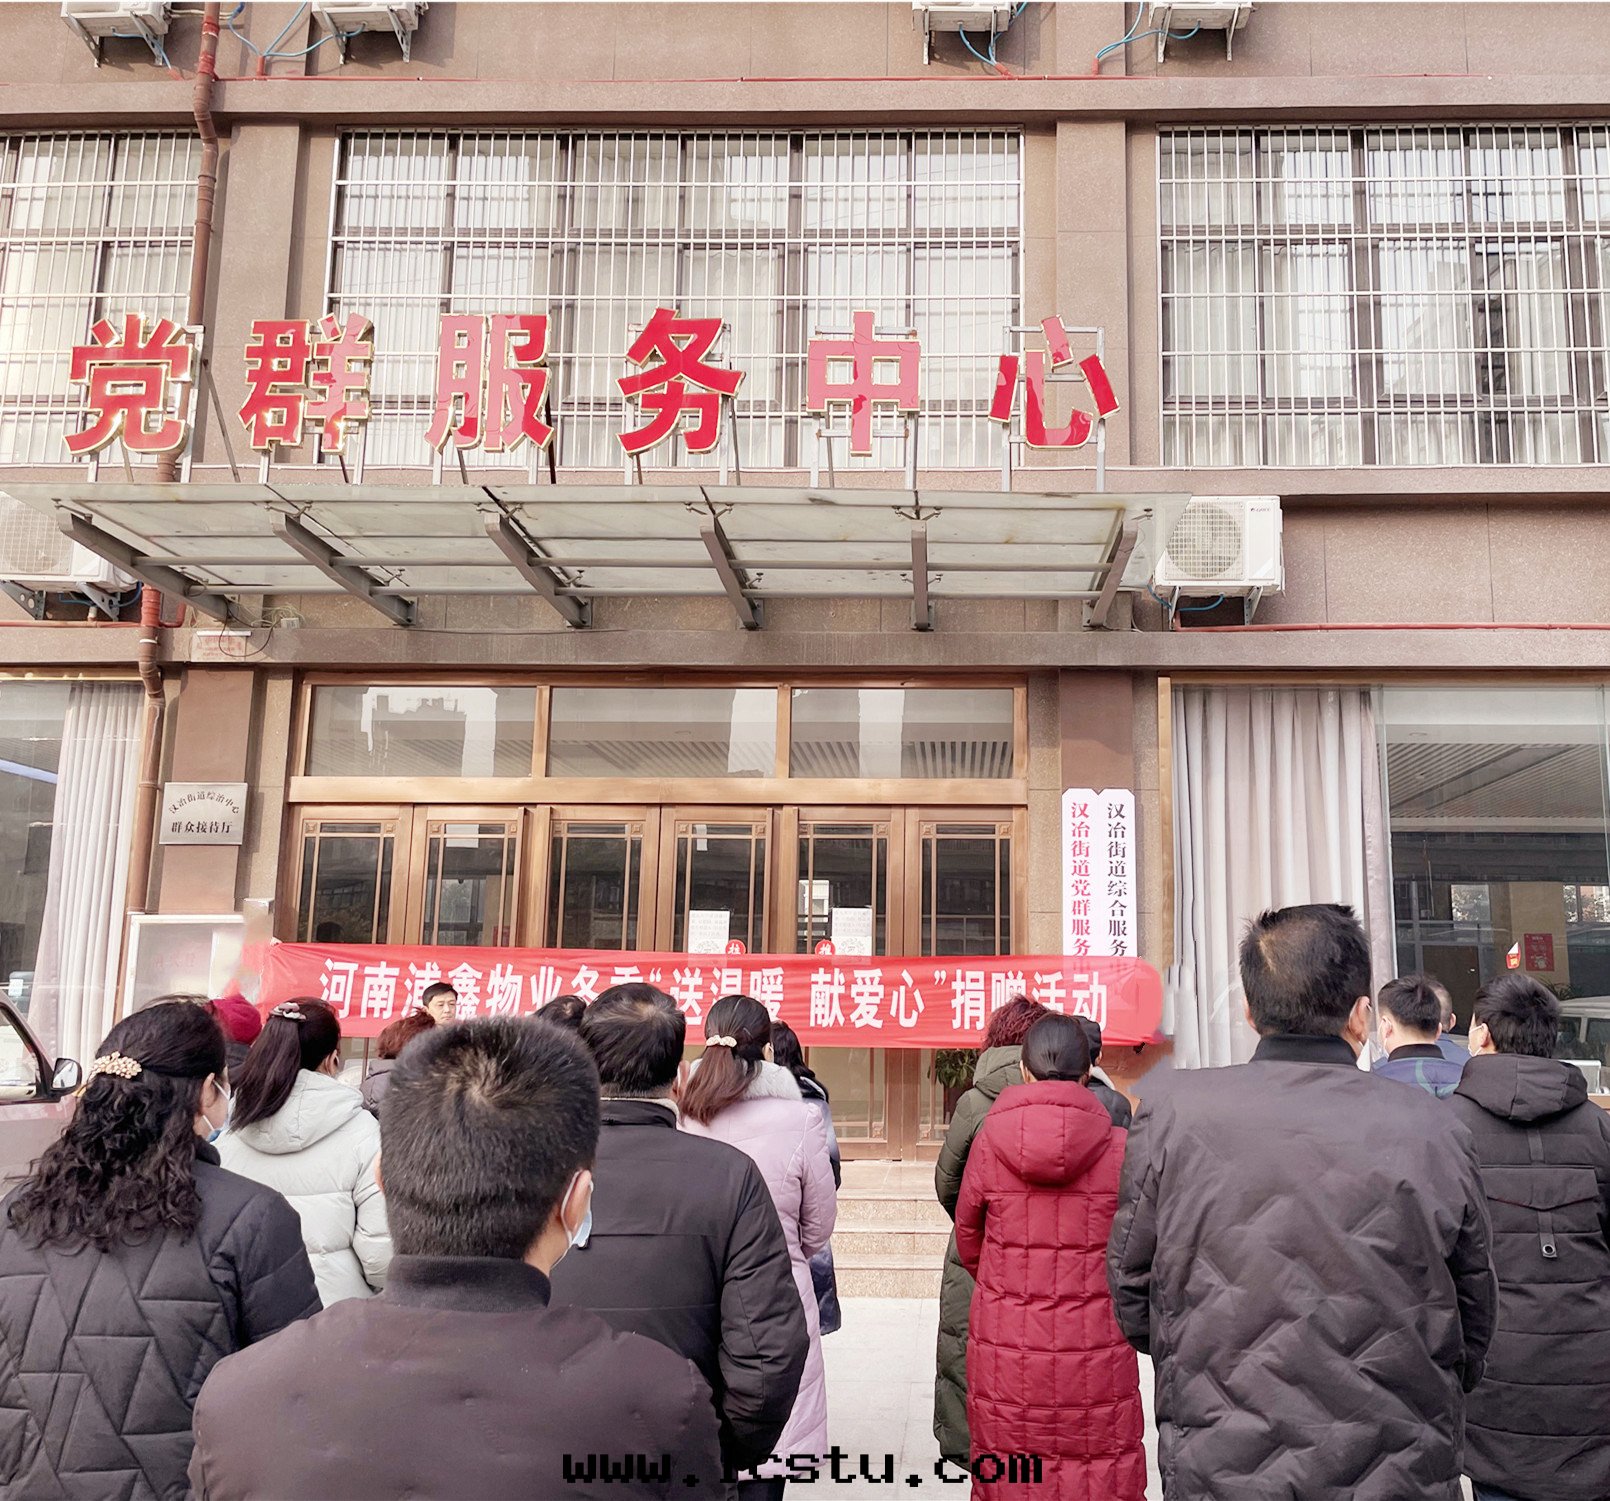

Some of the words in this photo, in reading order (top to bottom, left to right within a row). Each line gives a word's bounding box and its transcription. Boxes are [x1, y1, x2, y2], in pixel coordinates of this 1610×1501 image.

[64, 307, 1120, 456] 党群服务中心
[171, 821, 233, 834] 群众接待厅
